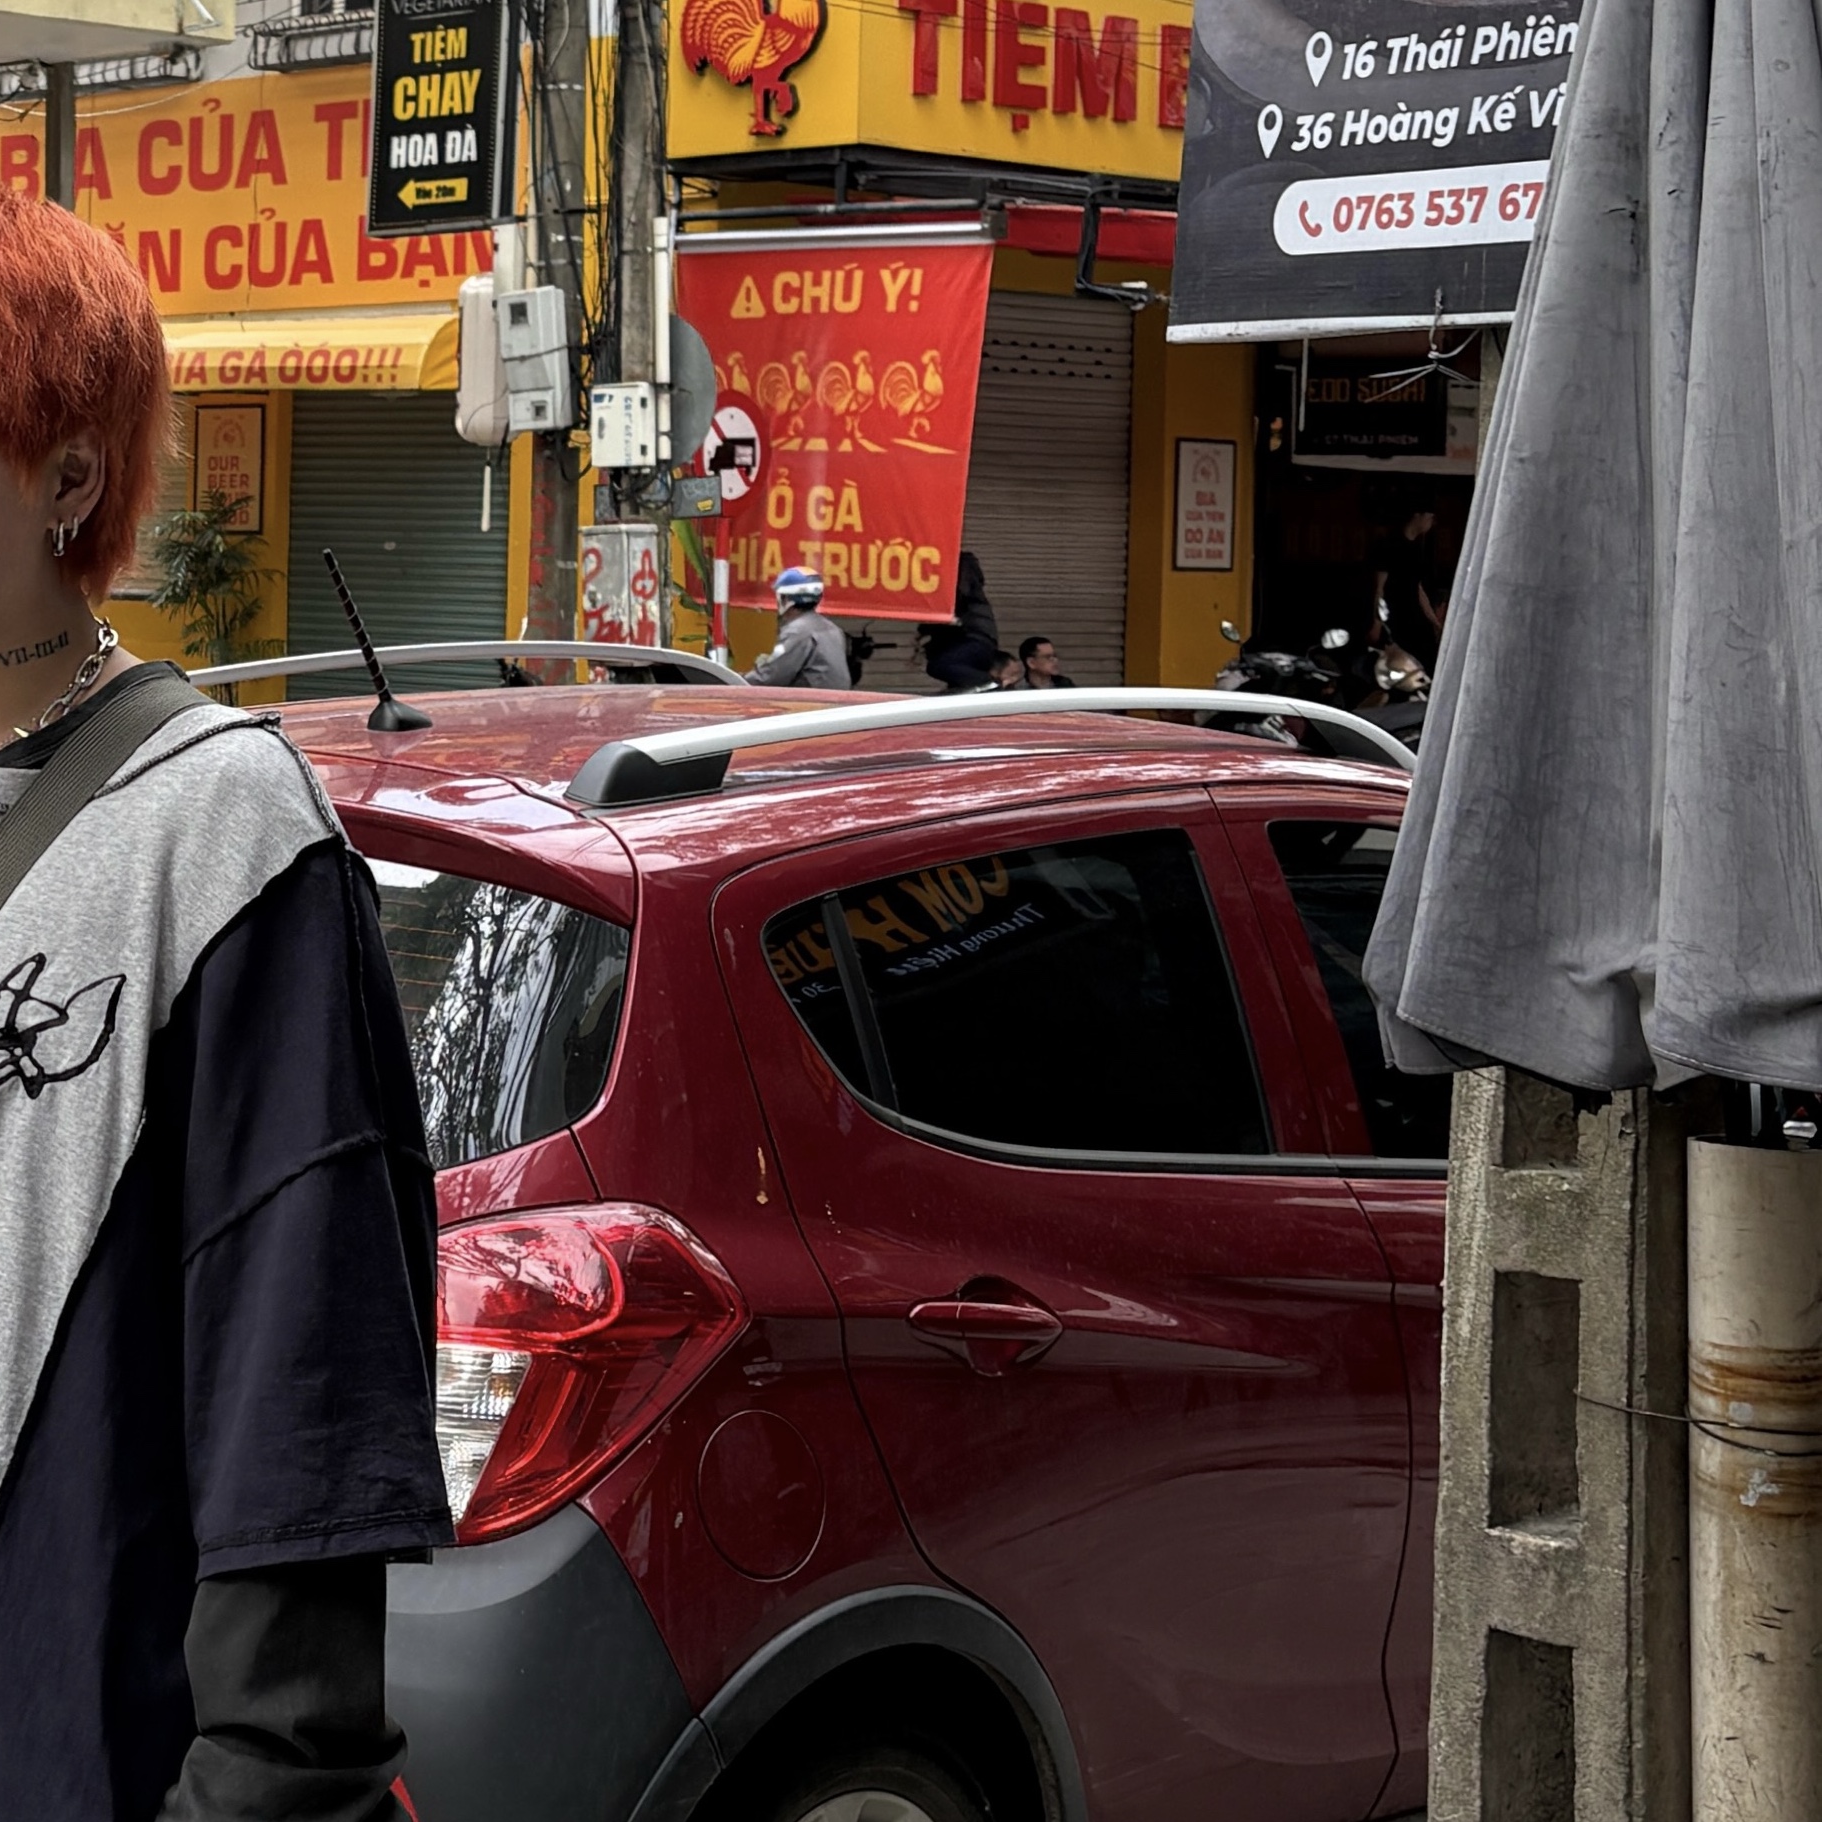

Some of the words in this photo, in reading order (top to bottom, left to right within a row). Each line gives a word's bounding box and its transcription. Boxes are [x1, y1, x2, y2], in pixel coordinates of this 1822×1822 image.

[410, 24, 468, 67] TIỆM
[1342, 39, 1378, 80] 16
[1386, 24, 1466, 75] Thái
[1470, 14, 1579, 65] Phiên
[392, 68, 482, 121] CHAY
[1290, 112, 1336, 152] 36
[1340, 102, 1460, 148] Hoàng
[1467, 85, 1525, 135] Kế
[1529, 82, 1567, 129] Vi
[1, 134, 112, 201] BA
[137, 98, 288, 196] CỦA
[389, 133, 439, 169] HOA
[444, 123, 478, 164] ĐÀ
[1333, 192, 1415, 233] 0763
[1424, 186, 1488, 227] 537
[1498, 181, 1544, 222] 67
[204, 207, 335, 292] CỦA
[772, 263, 864, 314] CHÚ
[880, 261, 924, 313] Ý!
[217, 343, 268, 384] GÀ
[208, 456, 239, 471] OUR
[208, 474, 249, 489] BEER
[767, 468, 794, 529] Ổ
[807, 479, 863, 533] GÀ
[703, 531, 784, 583] HÍA
[798, 537, 941, 594] TRƯỚC
